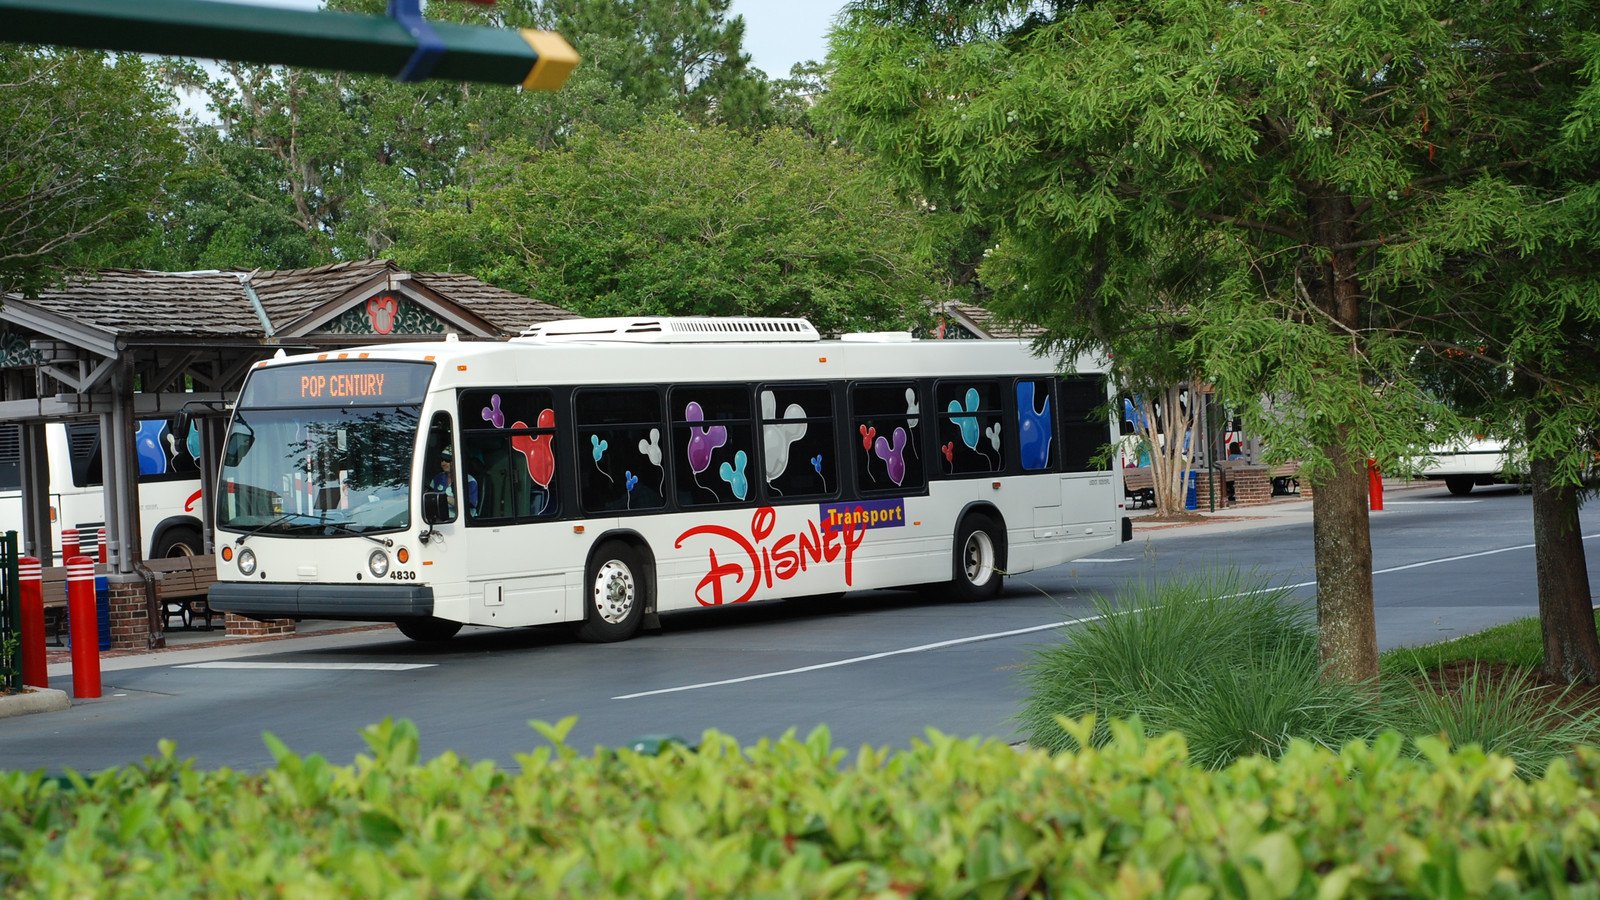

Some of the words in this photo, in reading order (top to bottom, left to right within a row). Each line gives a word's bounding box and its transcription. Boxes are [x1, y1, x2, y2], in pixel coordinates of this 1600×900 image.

[301, 375, 326, 397] POP
[329, 373, 385, 397] CENTURY
[827, 505, 902, 526] Transport
[390, 570, 416, 580] 4830
